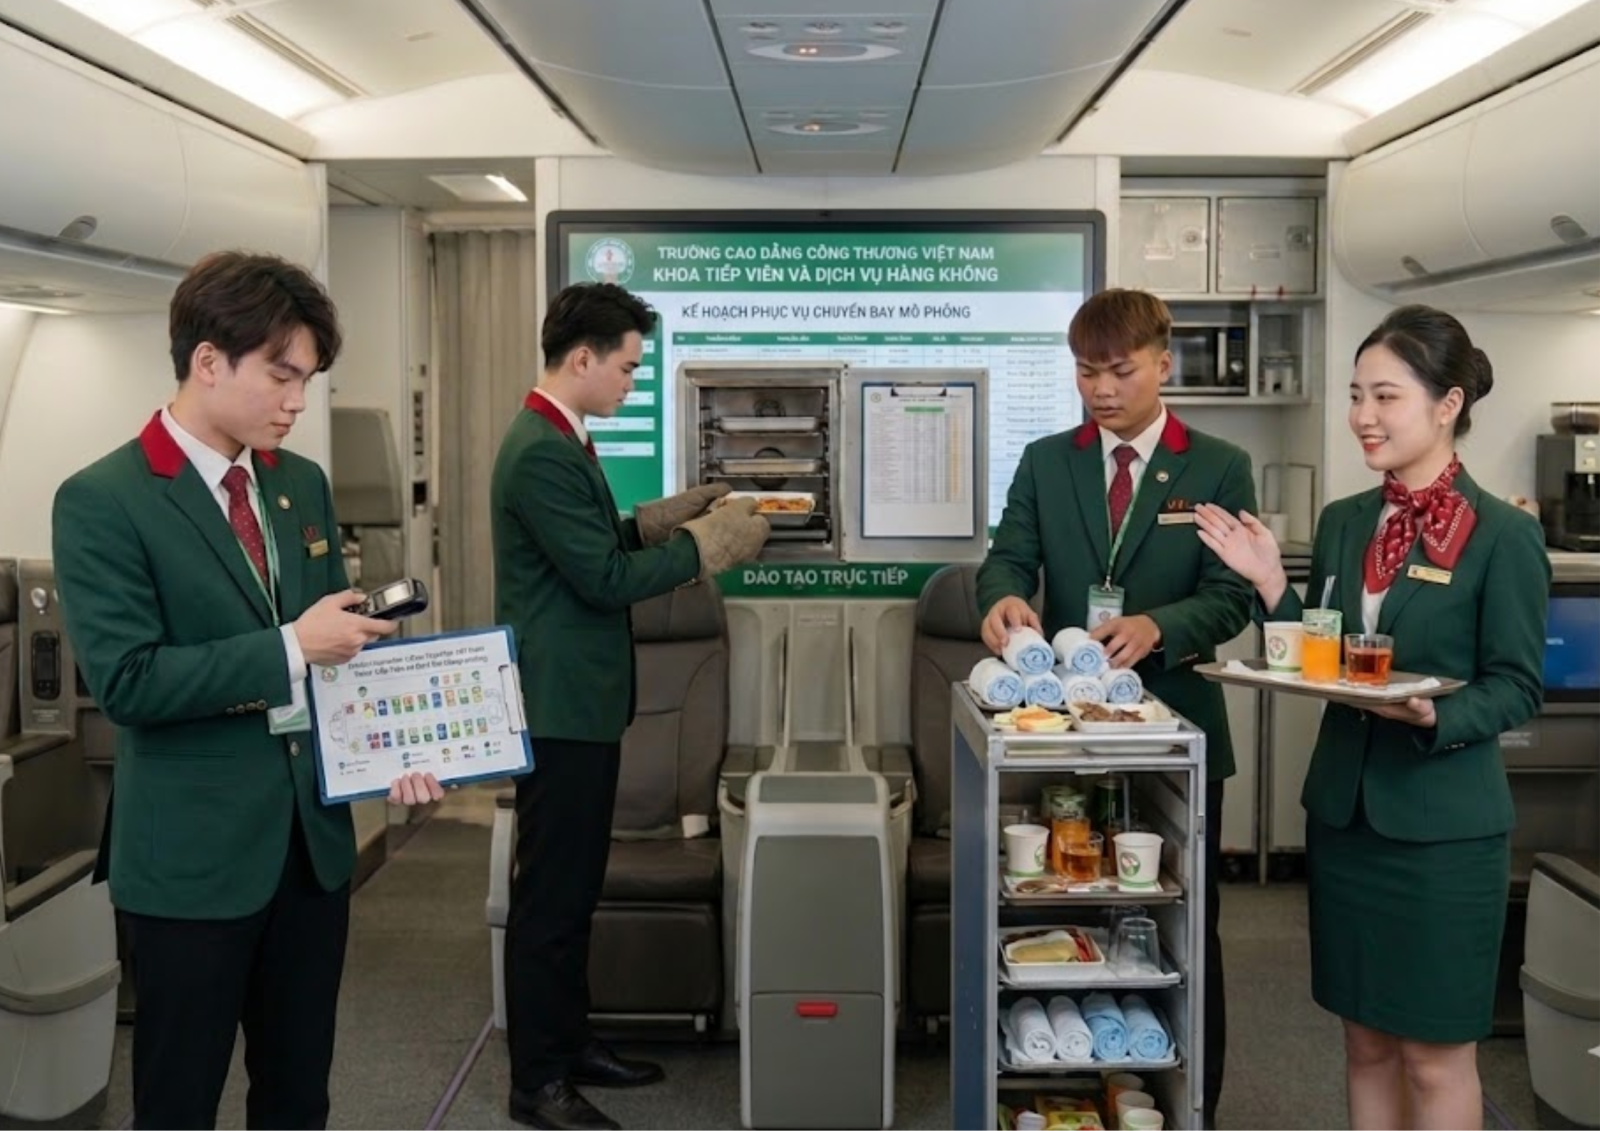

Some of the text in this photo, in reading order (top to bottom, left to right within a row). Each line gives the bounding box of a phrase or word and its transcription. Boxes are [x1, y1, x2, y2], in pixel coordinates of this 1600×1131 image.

[724, 246, 757, 260] CAO
[959, 246, 995, 260] NAM
[653, 267, 701, 283] KHOA
[745, 264, 784, 282] VIÊN
[859, 267, 883, 286] VỤ
[702, 305, 748, 322] HOẠCH
[791, 305, 810, 321] VỤ
[869, 305, 895, 319] BAY
